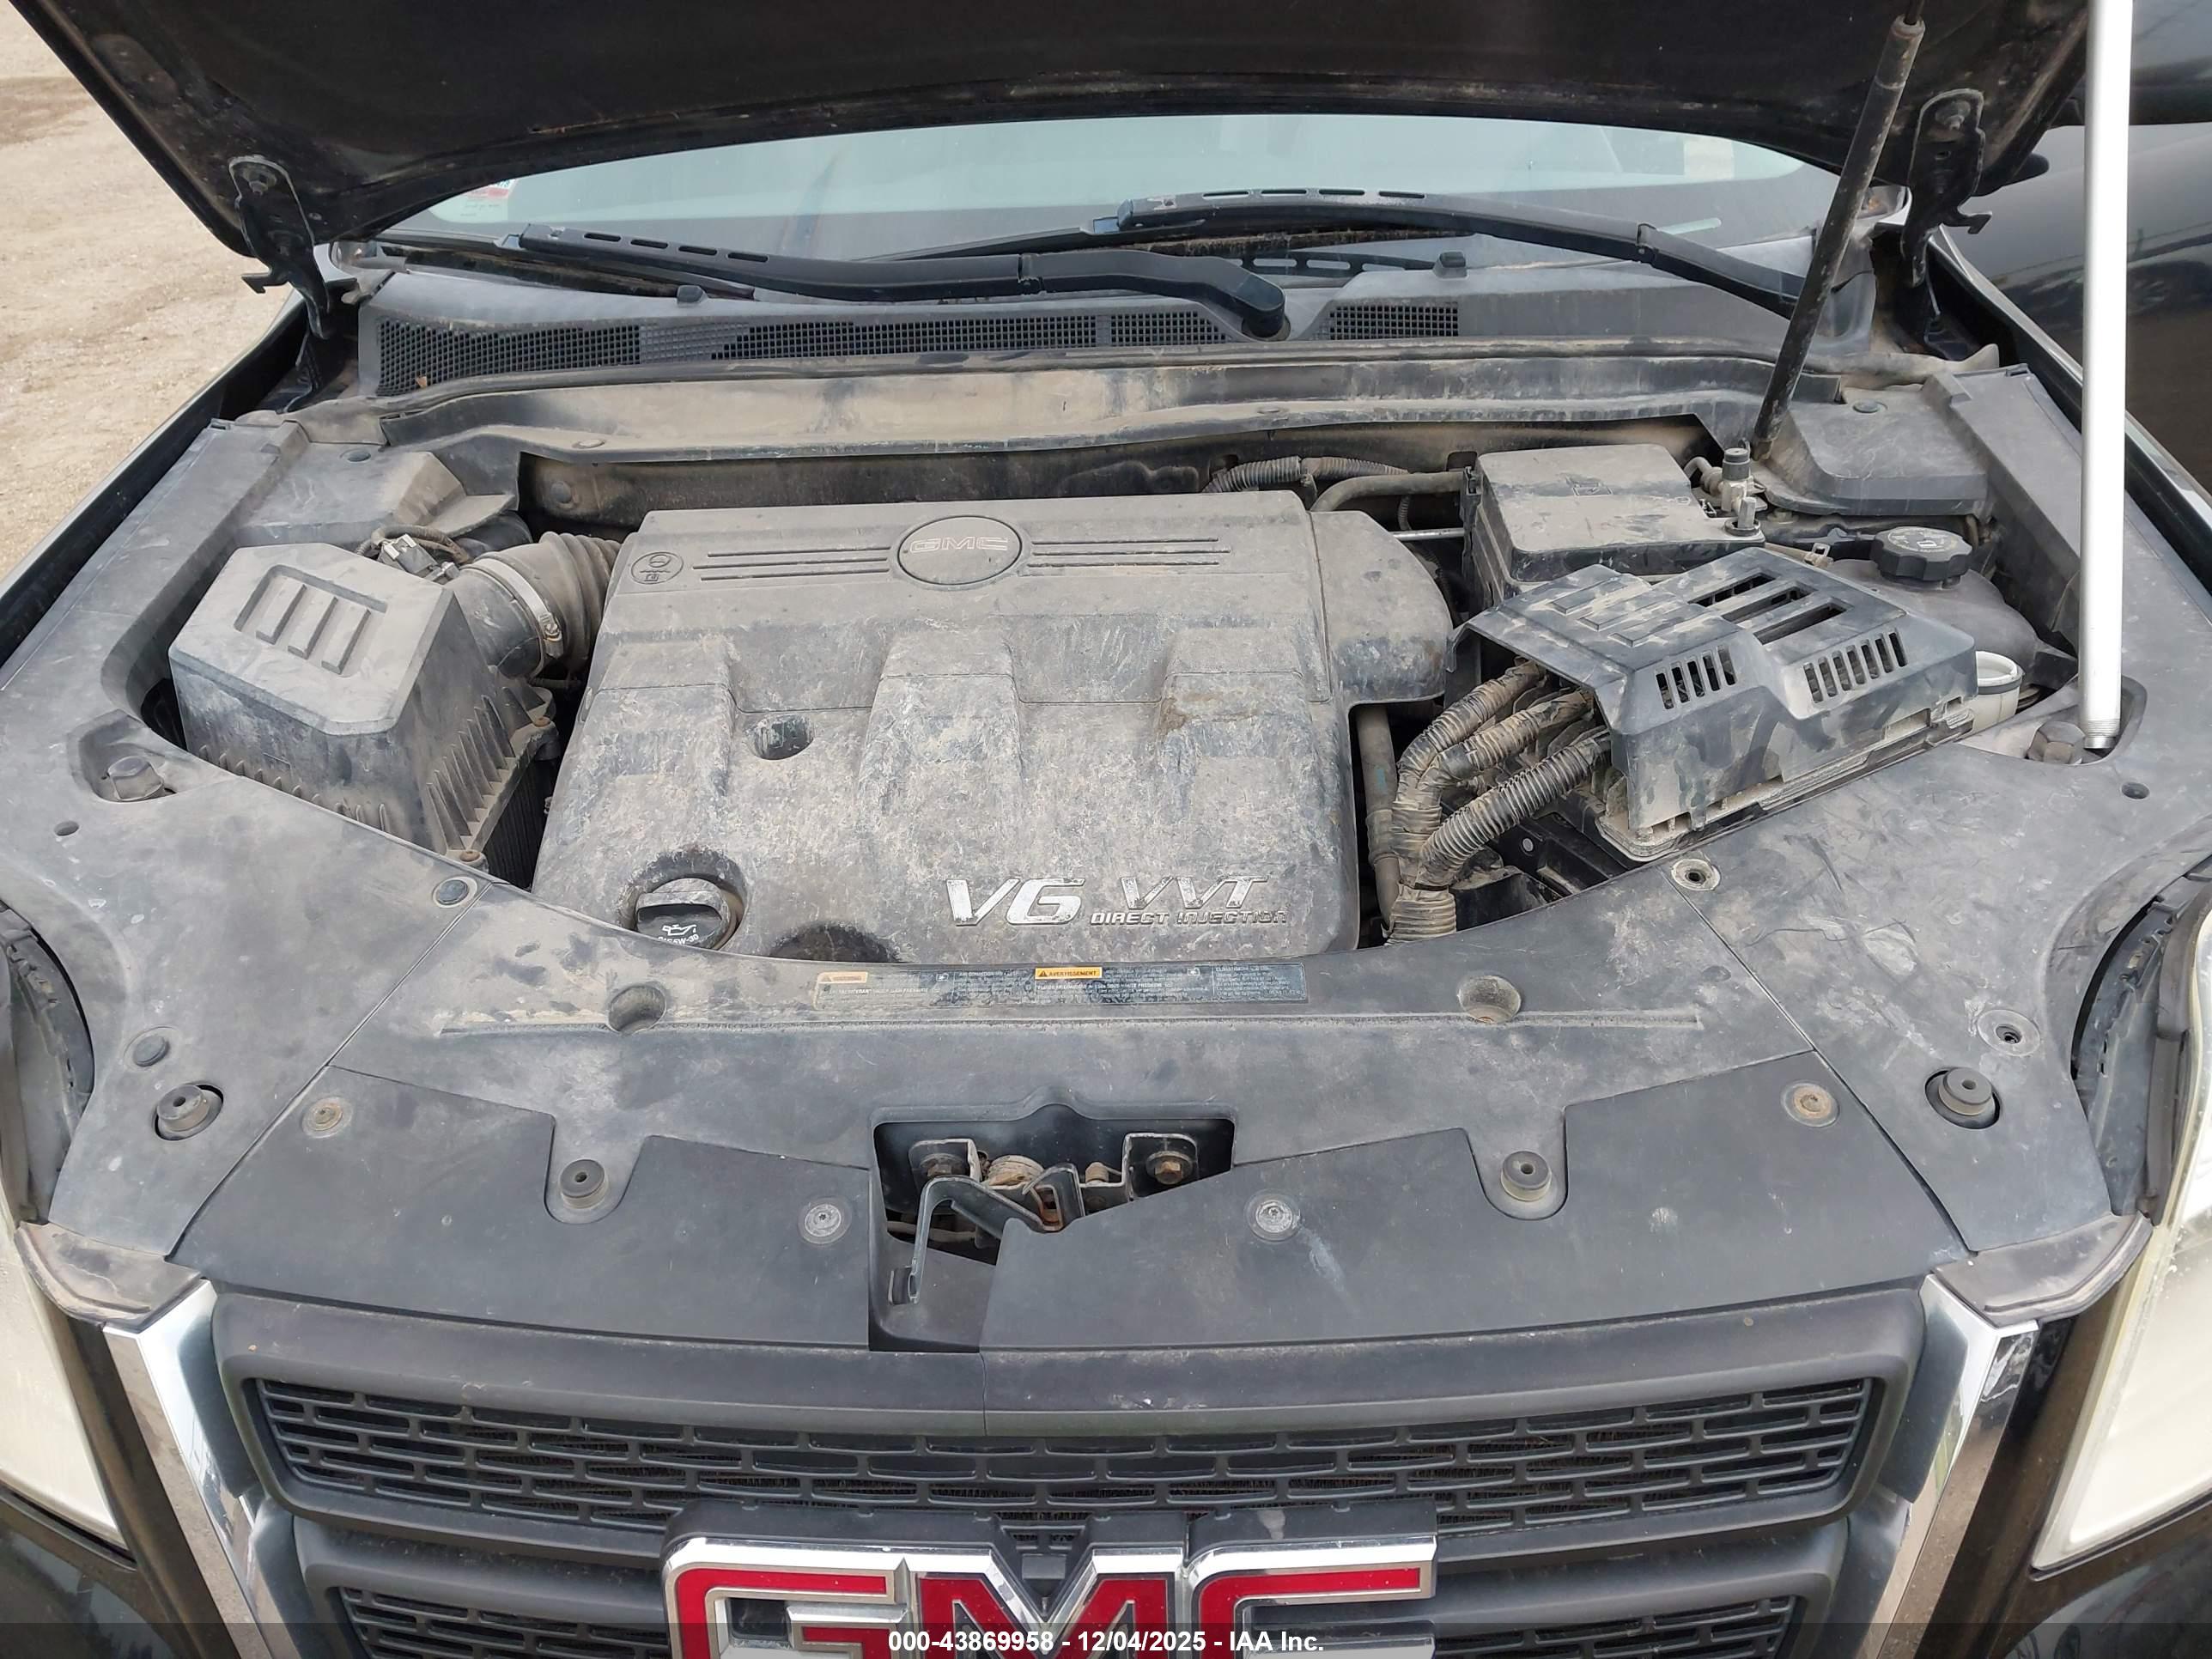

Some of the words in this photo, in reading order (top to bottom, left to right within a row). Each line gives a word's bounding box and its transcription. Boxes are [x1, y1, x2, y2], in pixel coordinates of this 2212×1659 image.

[909, 536, 1008, 553] GMC
[945, 878, 1085, 926] V6
[1120, 875, 1269, 909] VVT
[1090, 911, 1169, 925] DIRECT
[1176, 910, 1287, 925] INJECTION
[665, 1536, 1437, 1659] GMC
